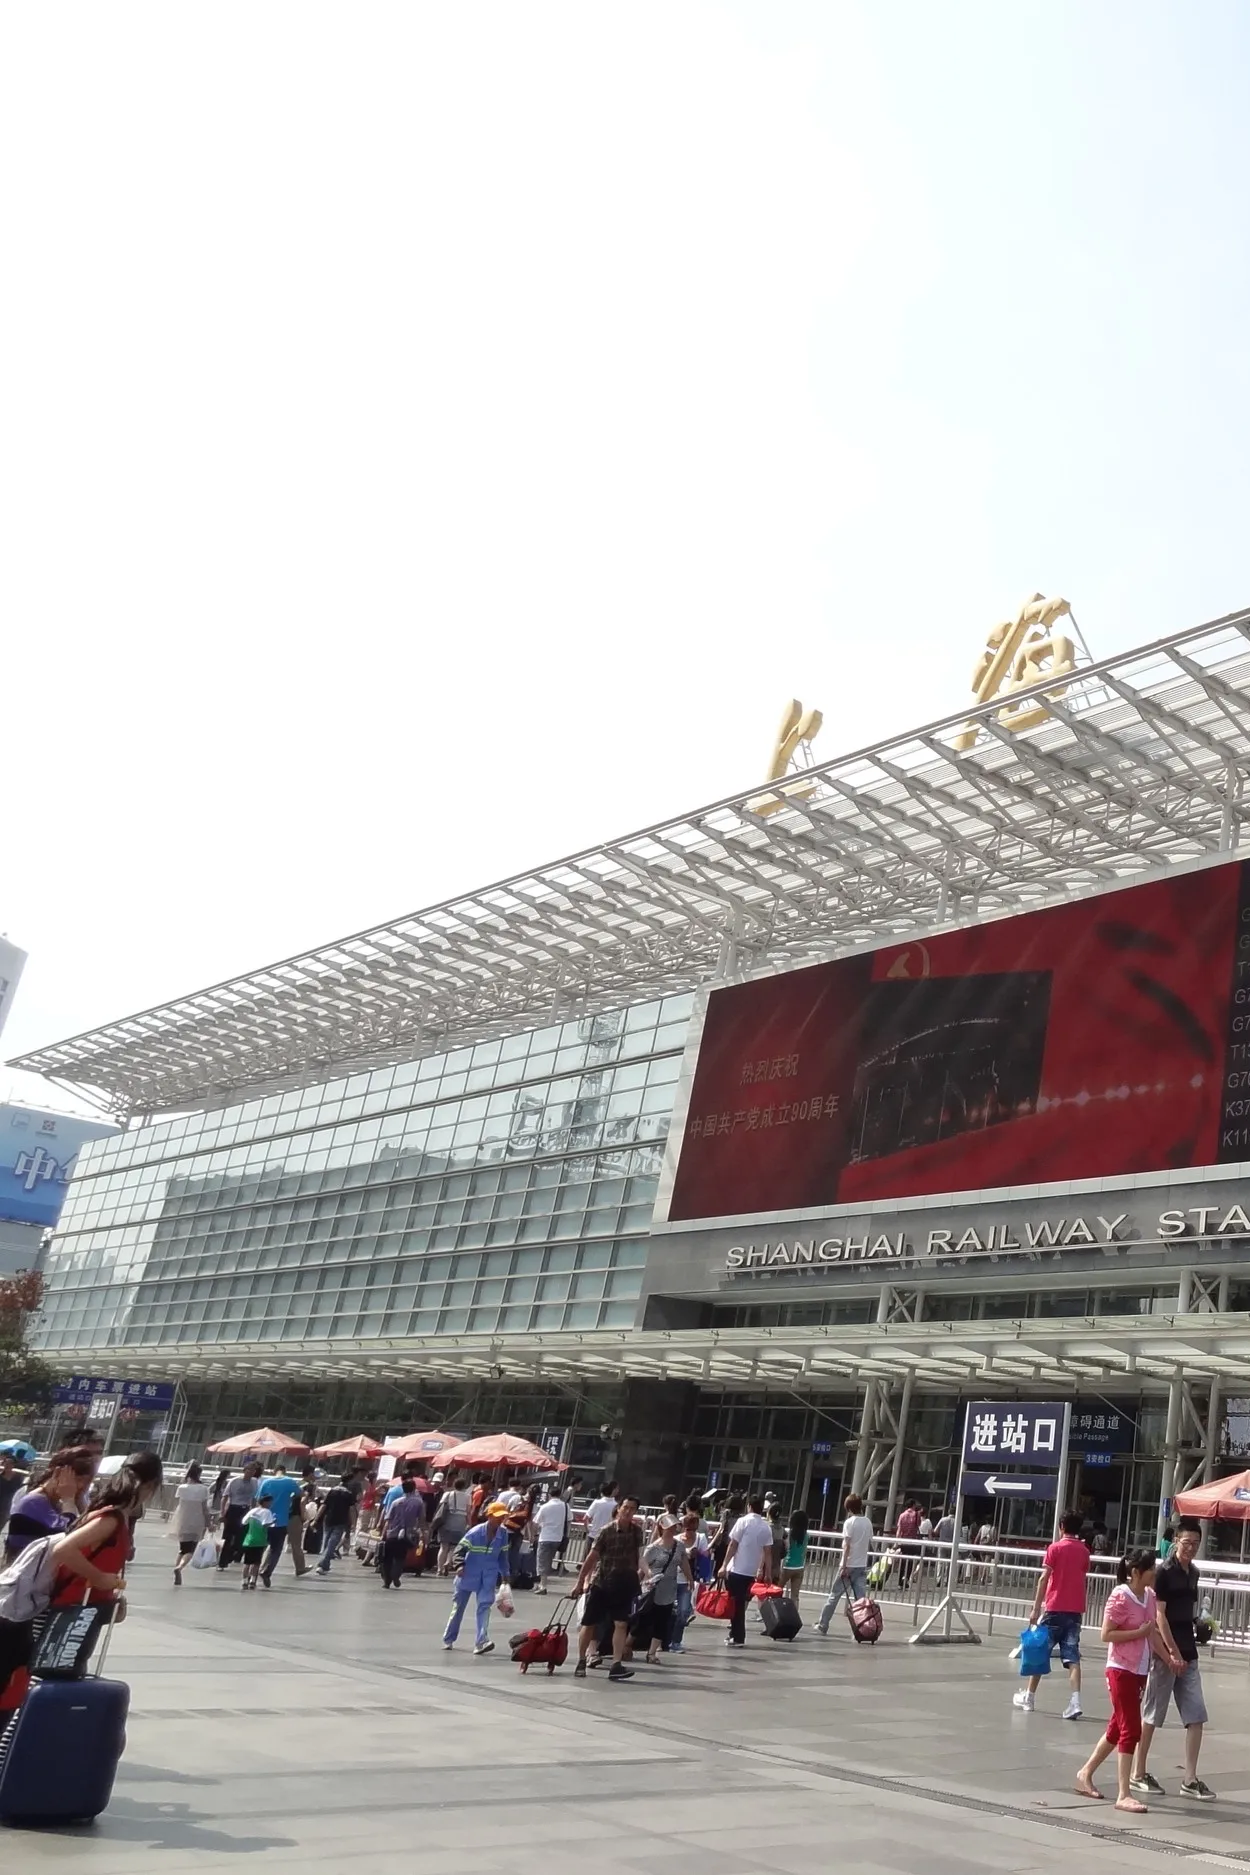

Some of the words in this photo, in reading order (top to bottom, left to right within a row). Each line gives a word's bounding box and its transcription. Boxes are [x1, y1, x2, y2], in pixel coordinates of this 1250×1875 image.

[739, 1053, 800, 1086] 热烈庆祝
[690, 1094, 840, 1139] 中国共产党成立90周年
[726, 1232, 905, 1268] SHANGHAI
[926, 1214, 1129, 1255] RAILWAY
[971, 1414, 1057, 1453] 进站口
[1086, 1454, 1111, 1463] 3安检口
